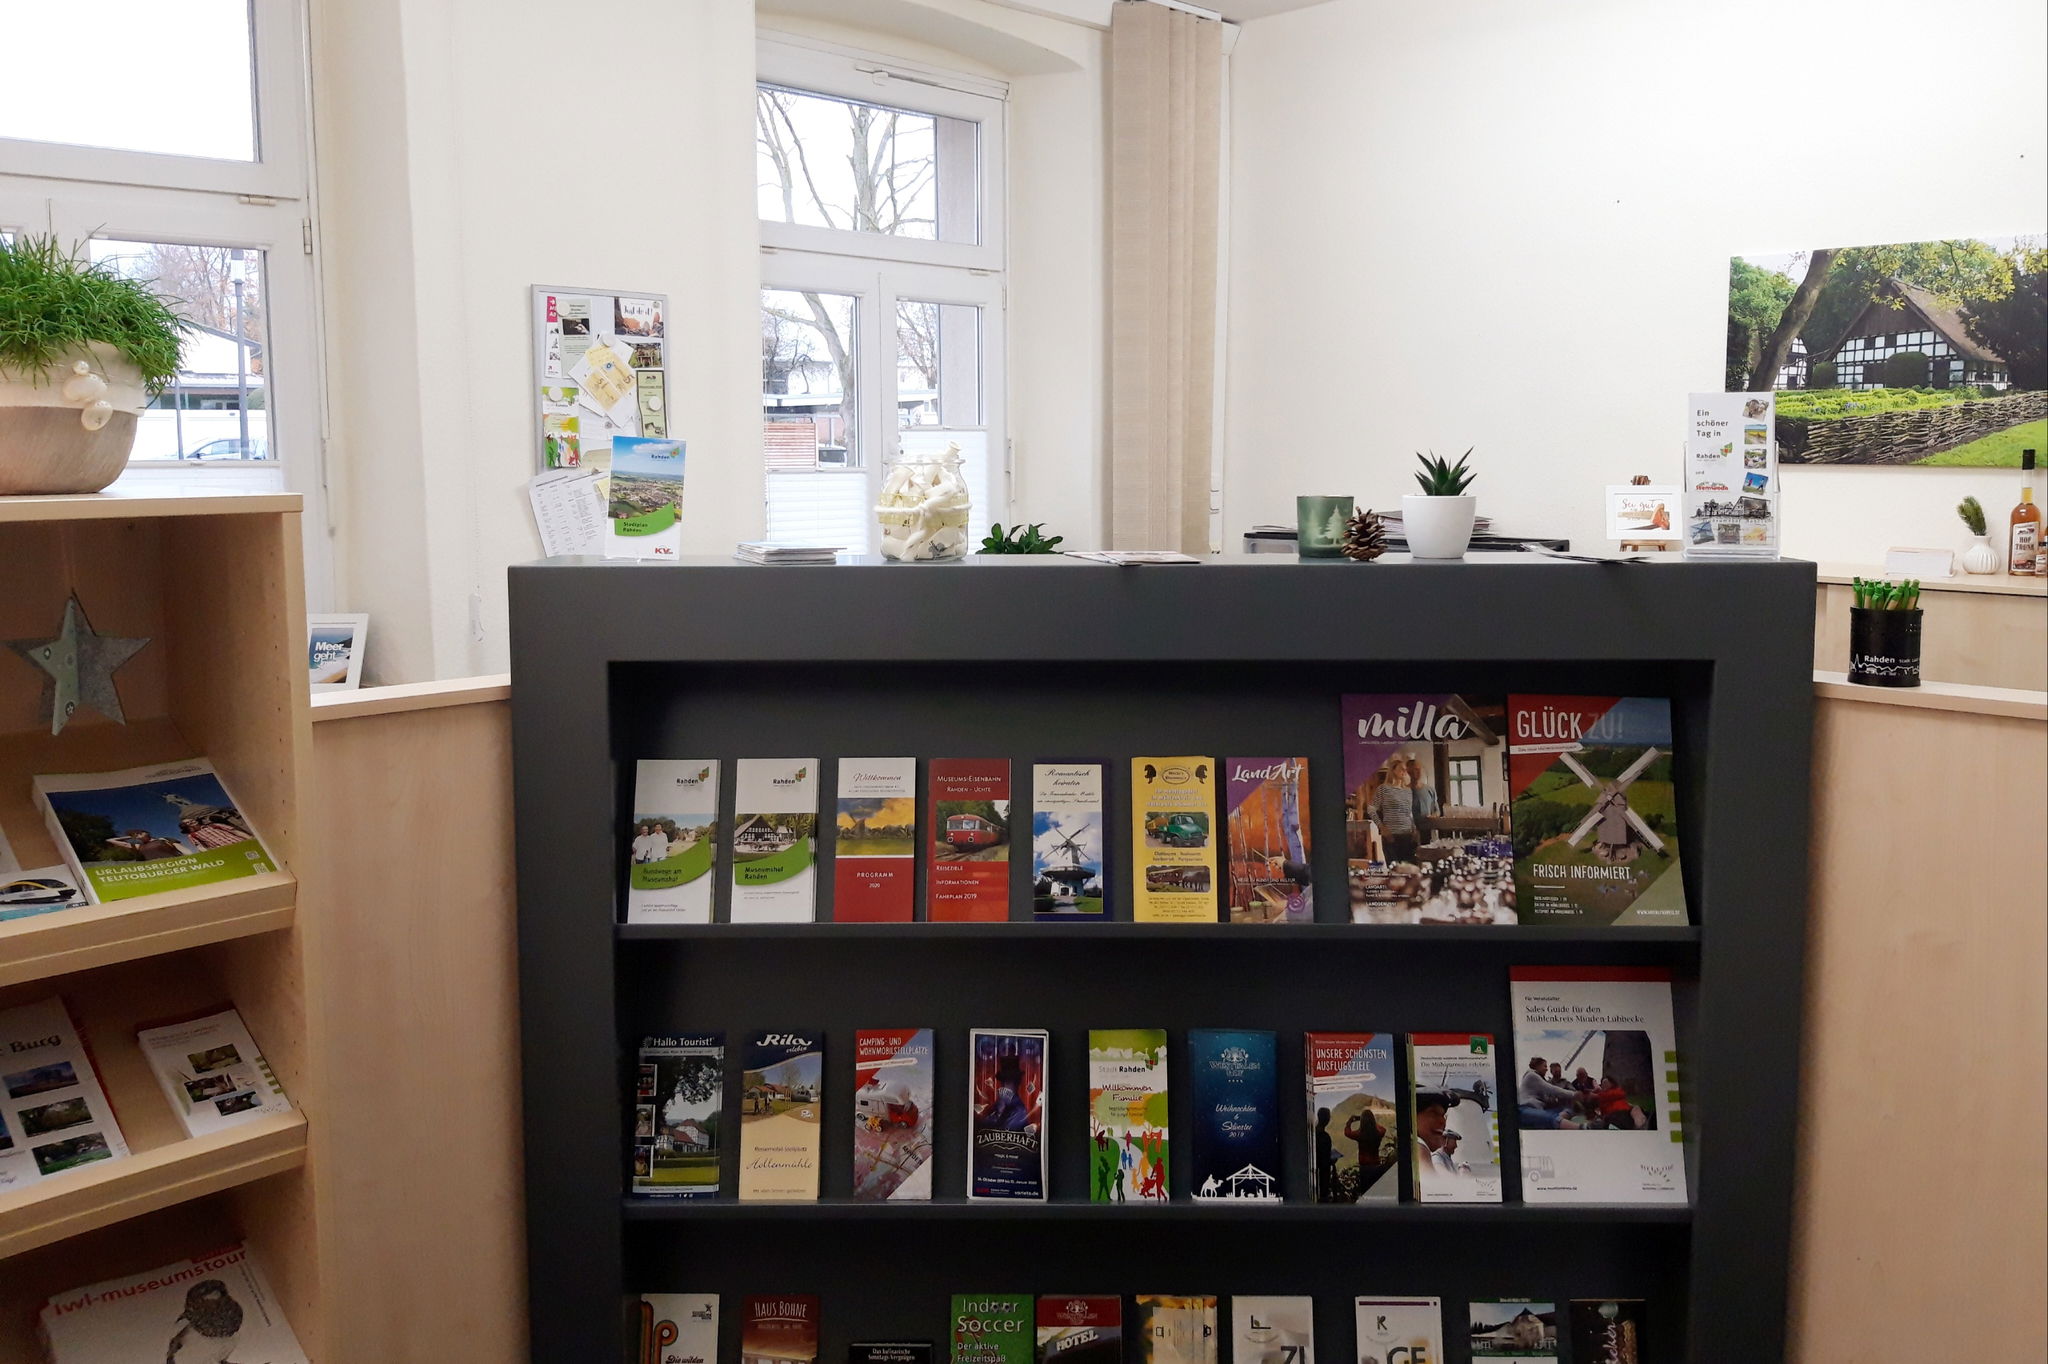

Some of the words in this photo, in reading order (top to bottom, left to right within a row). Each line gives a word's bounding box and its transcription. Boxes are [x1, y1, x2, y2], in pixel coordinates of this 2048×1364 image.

[1697, 409, 1710, 417] Ein
[1696, 419, 1729, 427] schöner
[1696, 430, 1712, 438] Tag
[315, 641, 345, 651] Meer
[313, 651, 337, 663] geht
[1864, 655, 1895, 663] Rahden
[1357, 700, 1470, 742] milla
[1516, 705, 1583, 739] GLÜCK
[1231, 762, 1305, 783] LandArt
[95, 857, 198, 877] URLAUBSREGION
[98, 866, 188, 883] TEUTOBURGER
[189, 859, 225, 872] WALD
[1533, 863, 1567, 878] FRISCH
[1570, 865, 1631, 880] INFORMIERT
[1525, 1005, 1545, 1013] Sales
[1547, 1005, 1570, 1014] Guide
[1572, 1005, 1584, 1013] für
[1585, 1005, 1601, 1013] den
[653, 1037, 677, 1047] Hallo
[679, 1037, 713, 1047] Tourist!
[755, 1033, 813, 1047] Rila
[889, 1037, 902, 1045] UND
[1315, 1048, 1343, 1059] UNSERE
[1344, 1046, 1387, 1060] SCHÖNSTEN
[1316, 1060, 1371, 1072] AUSFLUGSZIELE
[1102, 1084, 1153, 1092] Willkommen
[1112, 1093, 1143, 1102] Familie
[976, 1131, 1039, 1149] ZAUBERHAFT
[54, 1250, 247, 1317] lwl-museumstour
[755, 1301, 777, 1318] HAUS
[779, 1300, 808, 1318] BOHNE
[963, 1298, 1020, 1313] Indoor
[957, 1315, 1025, 1333] Soccer
[957, 1342, 972, 1351] Der
[974, 1342, 1000, 1351] aktive
[1055, 1329, 1100, 1352] HOTEL
[957, 1354, 1006, 1364] Freizeitspaß
